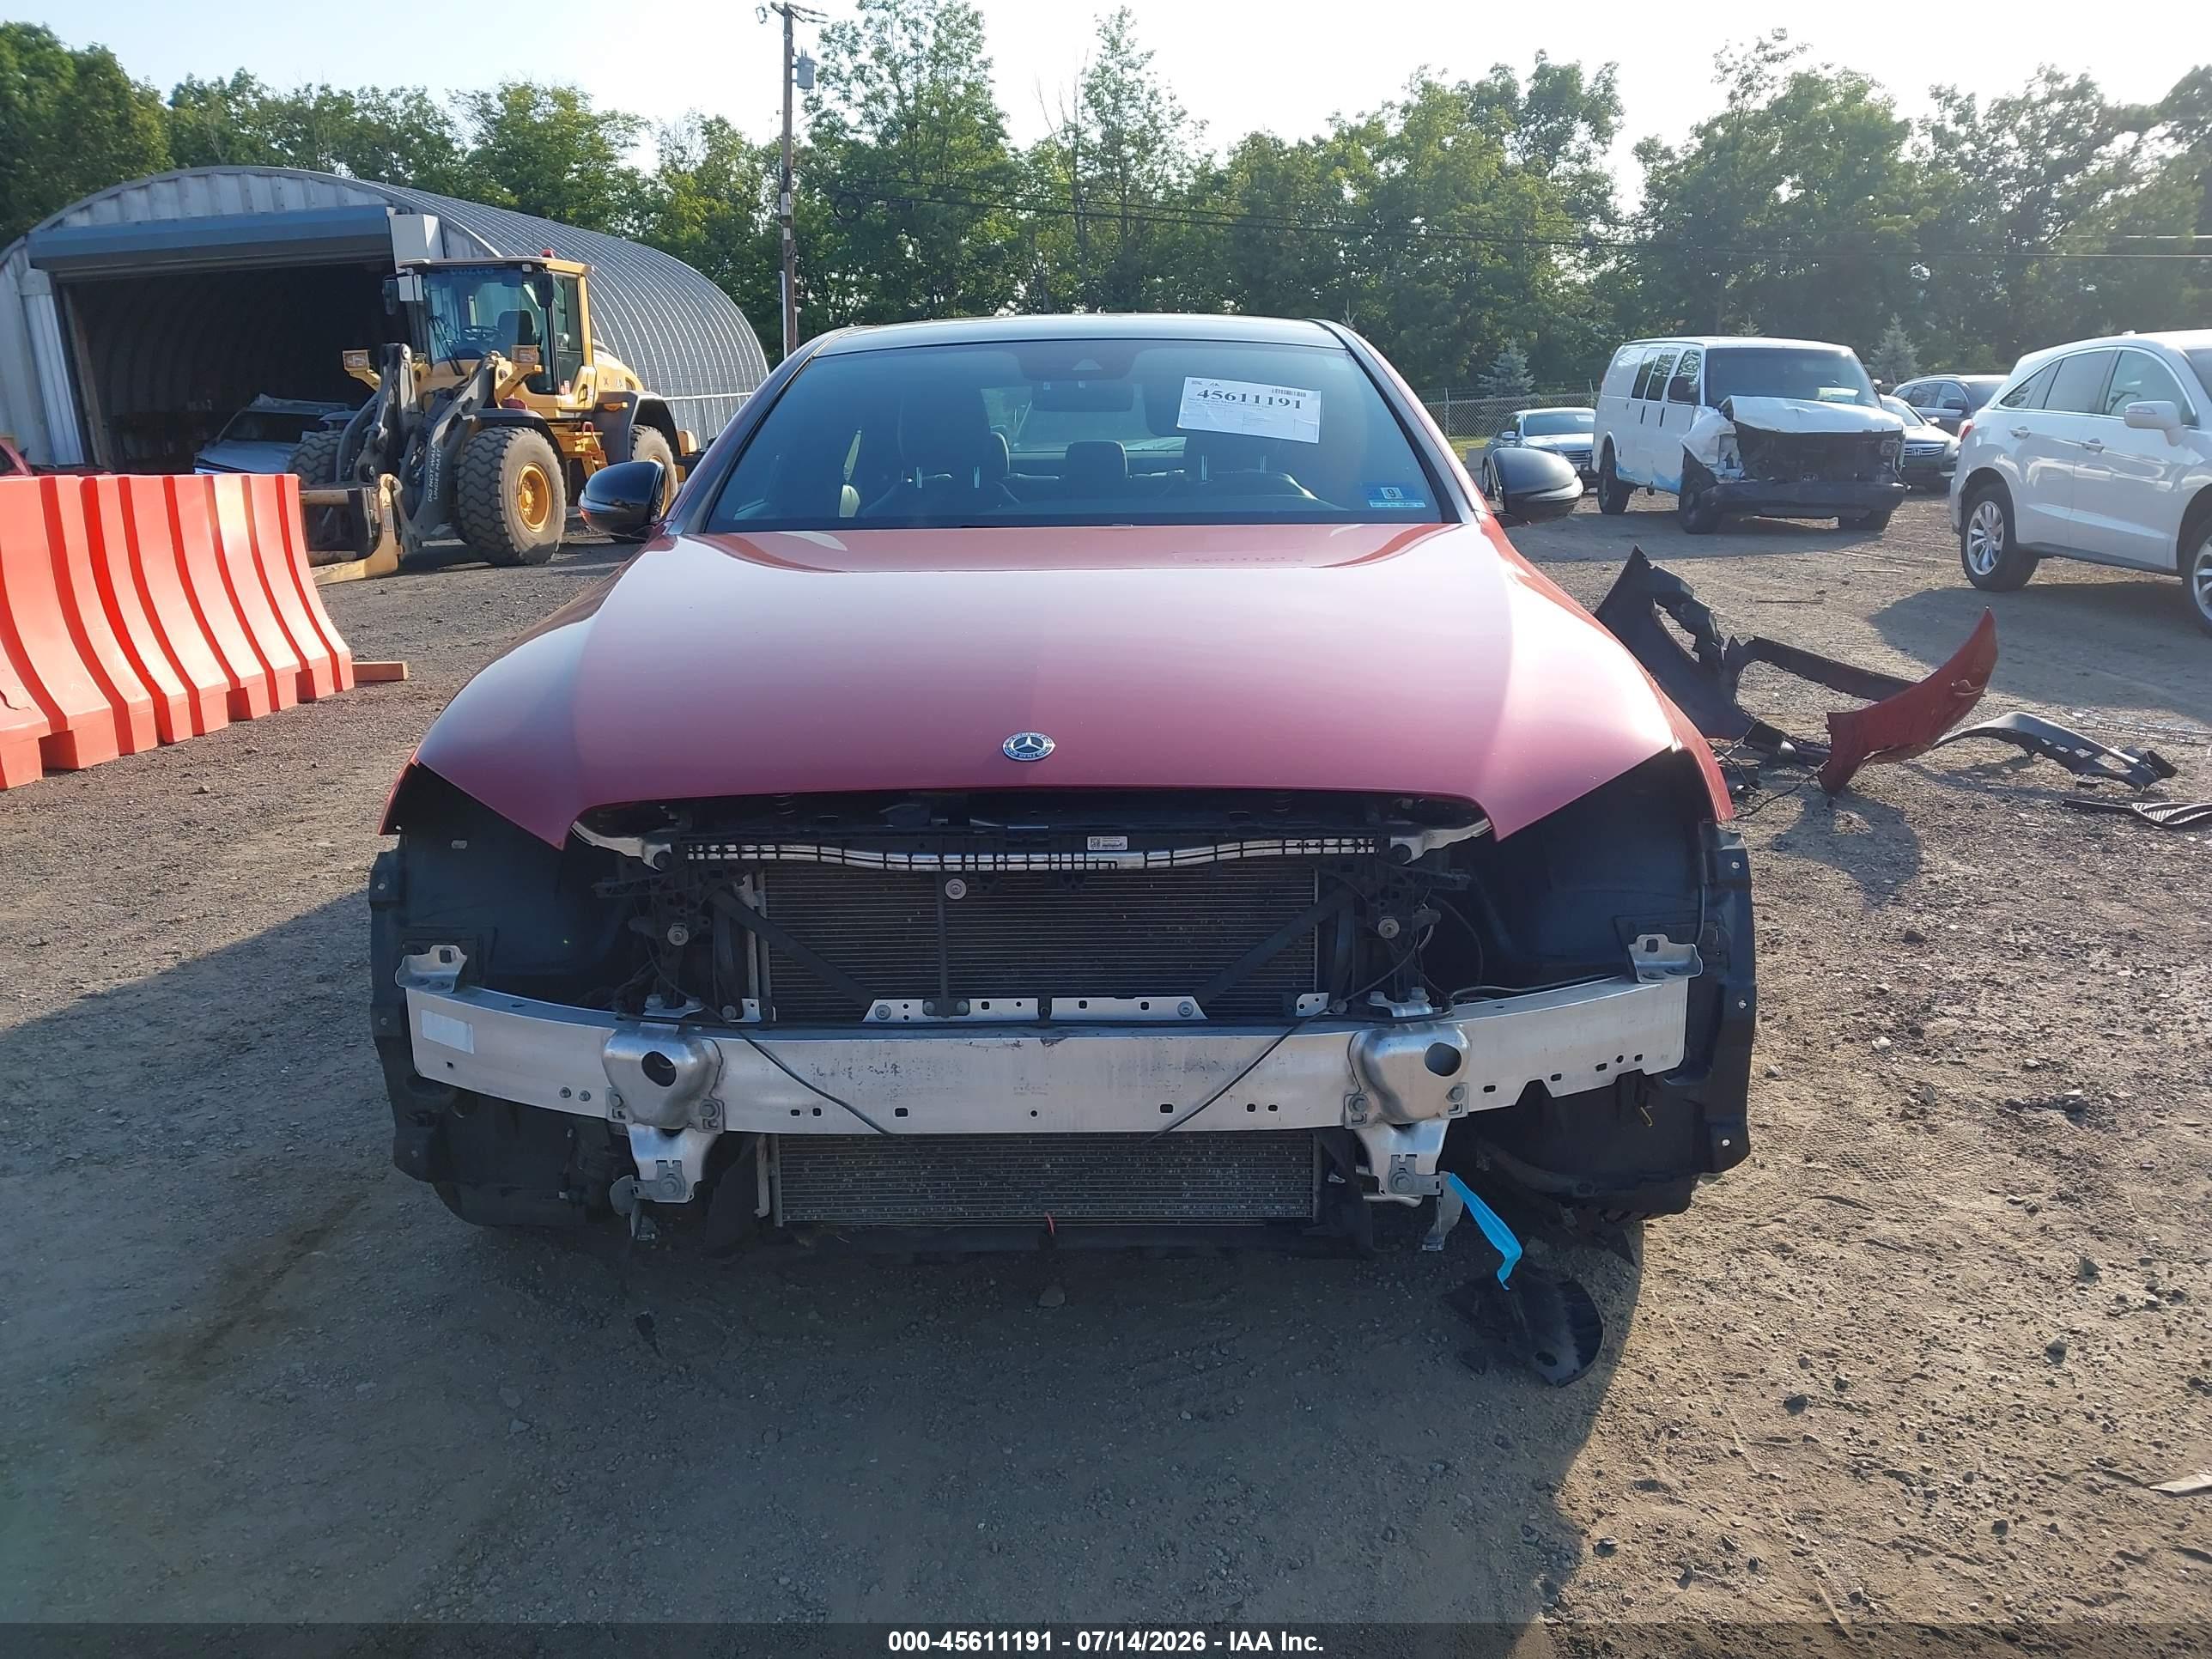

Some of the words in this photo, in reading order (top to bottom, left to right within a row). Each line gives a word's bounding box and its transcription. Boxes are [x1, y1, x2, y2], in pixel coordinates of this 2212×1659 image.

[1196, 389, 1302, 410] 45611191
[427, 489, 433, 502] DO
[1387, 488, 1396, 498] 9
